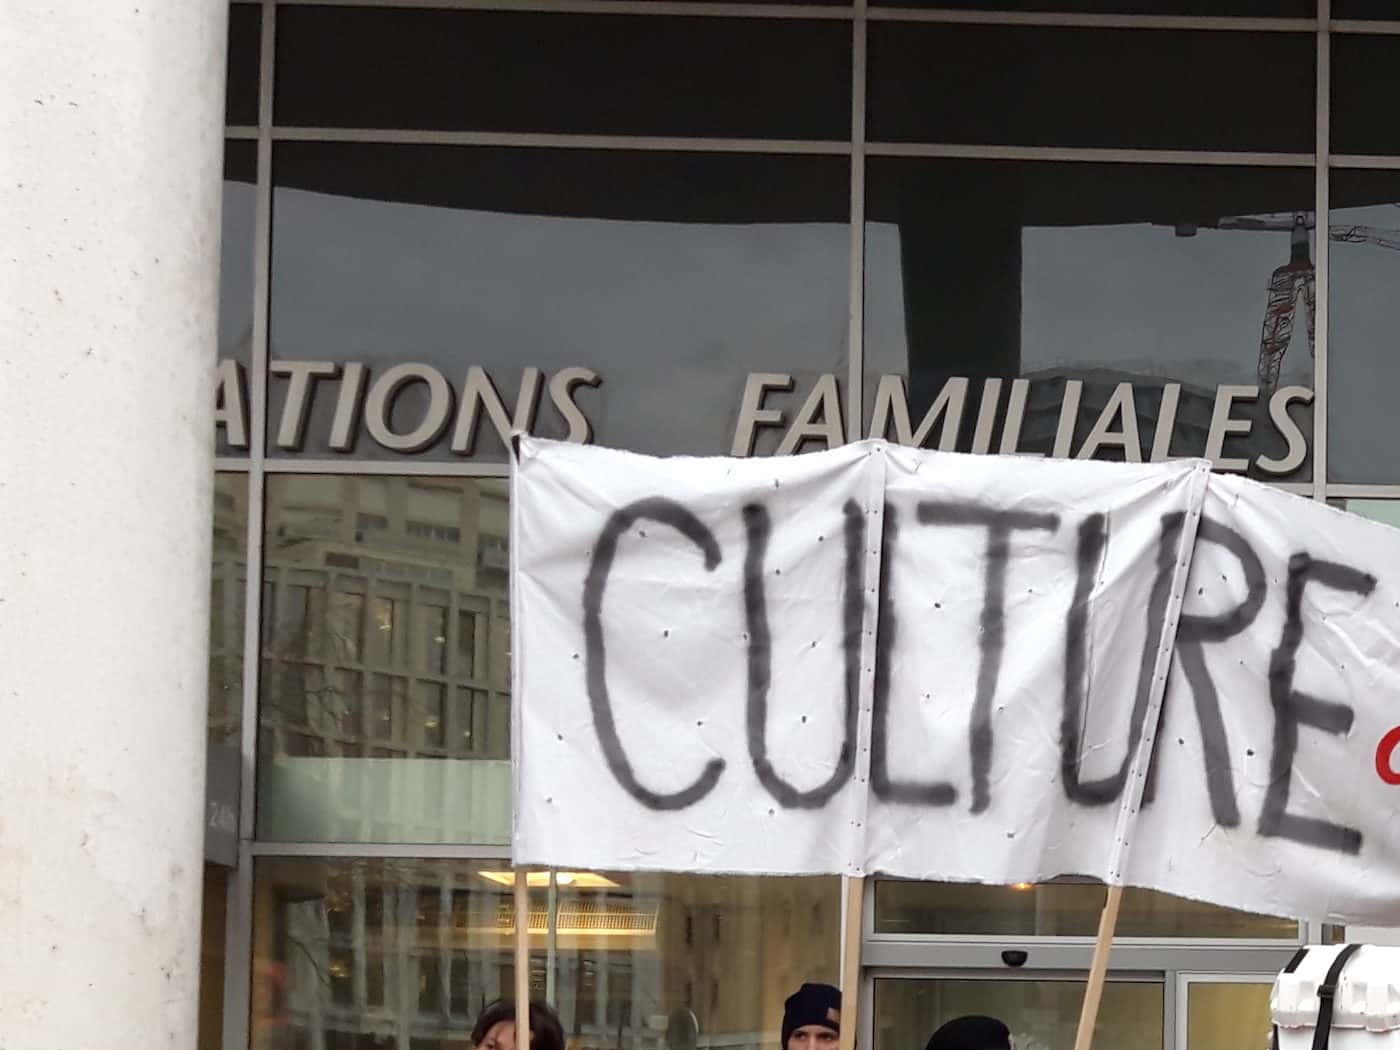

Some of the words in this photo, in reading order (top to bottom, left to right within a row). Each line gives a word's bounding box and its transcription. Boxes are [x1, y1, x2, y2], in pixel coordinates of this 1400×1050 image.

[214, 359, 602, 456] ATIONS
[730, 372, 1316, 476] FAMILIALES
[583, 497, 1378, 855] CULTURE
